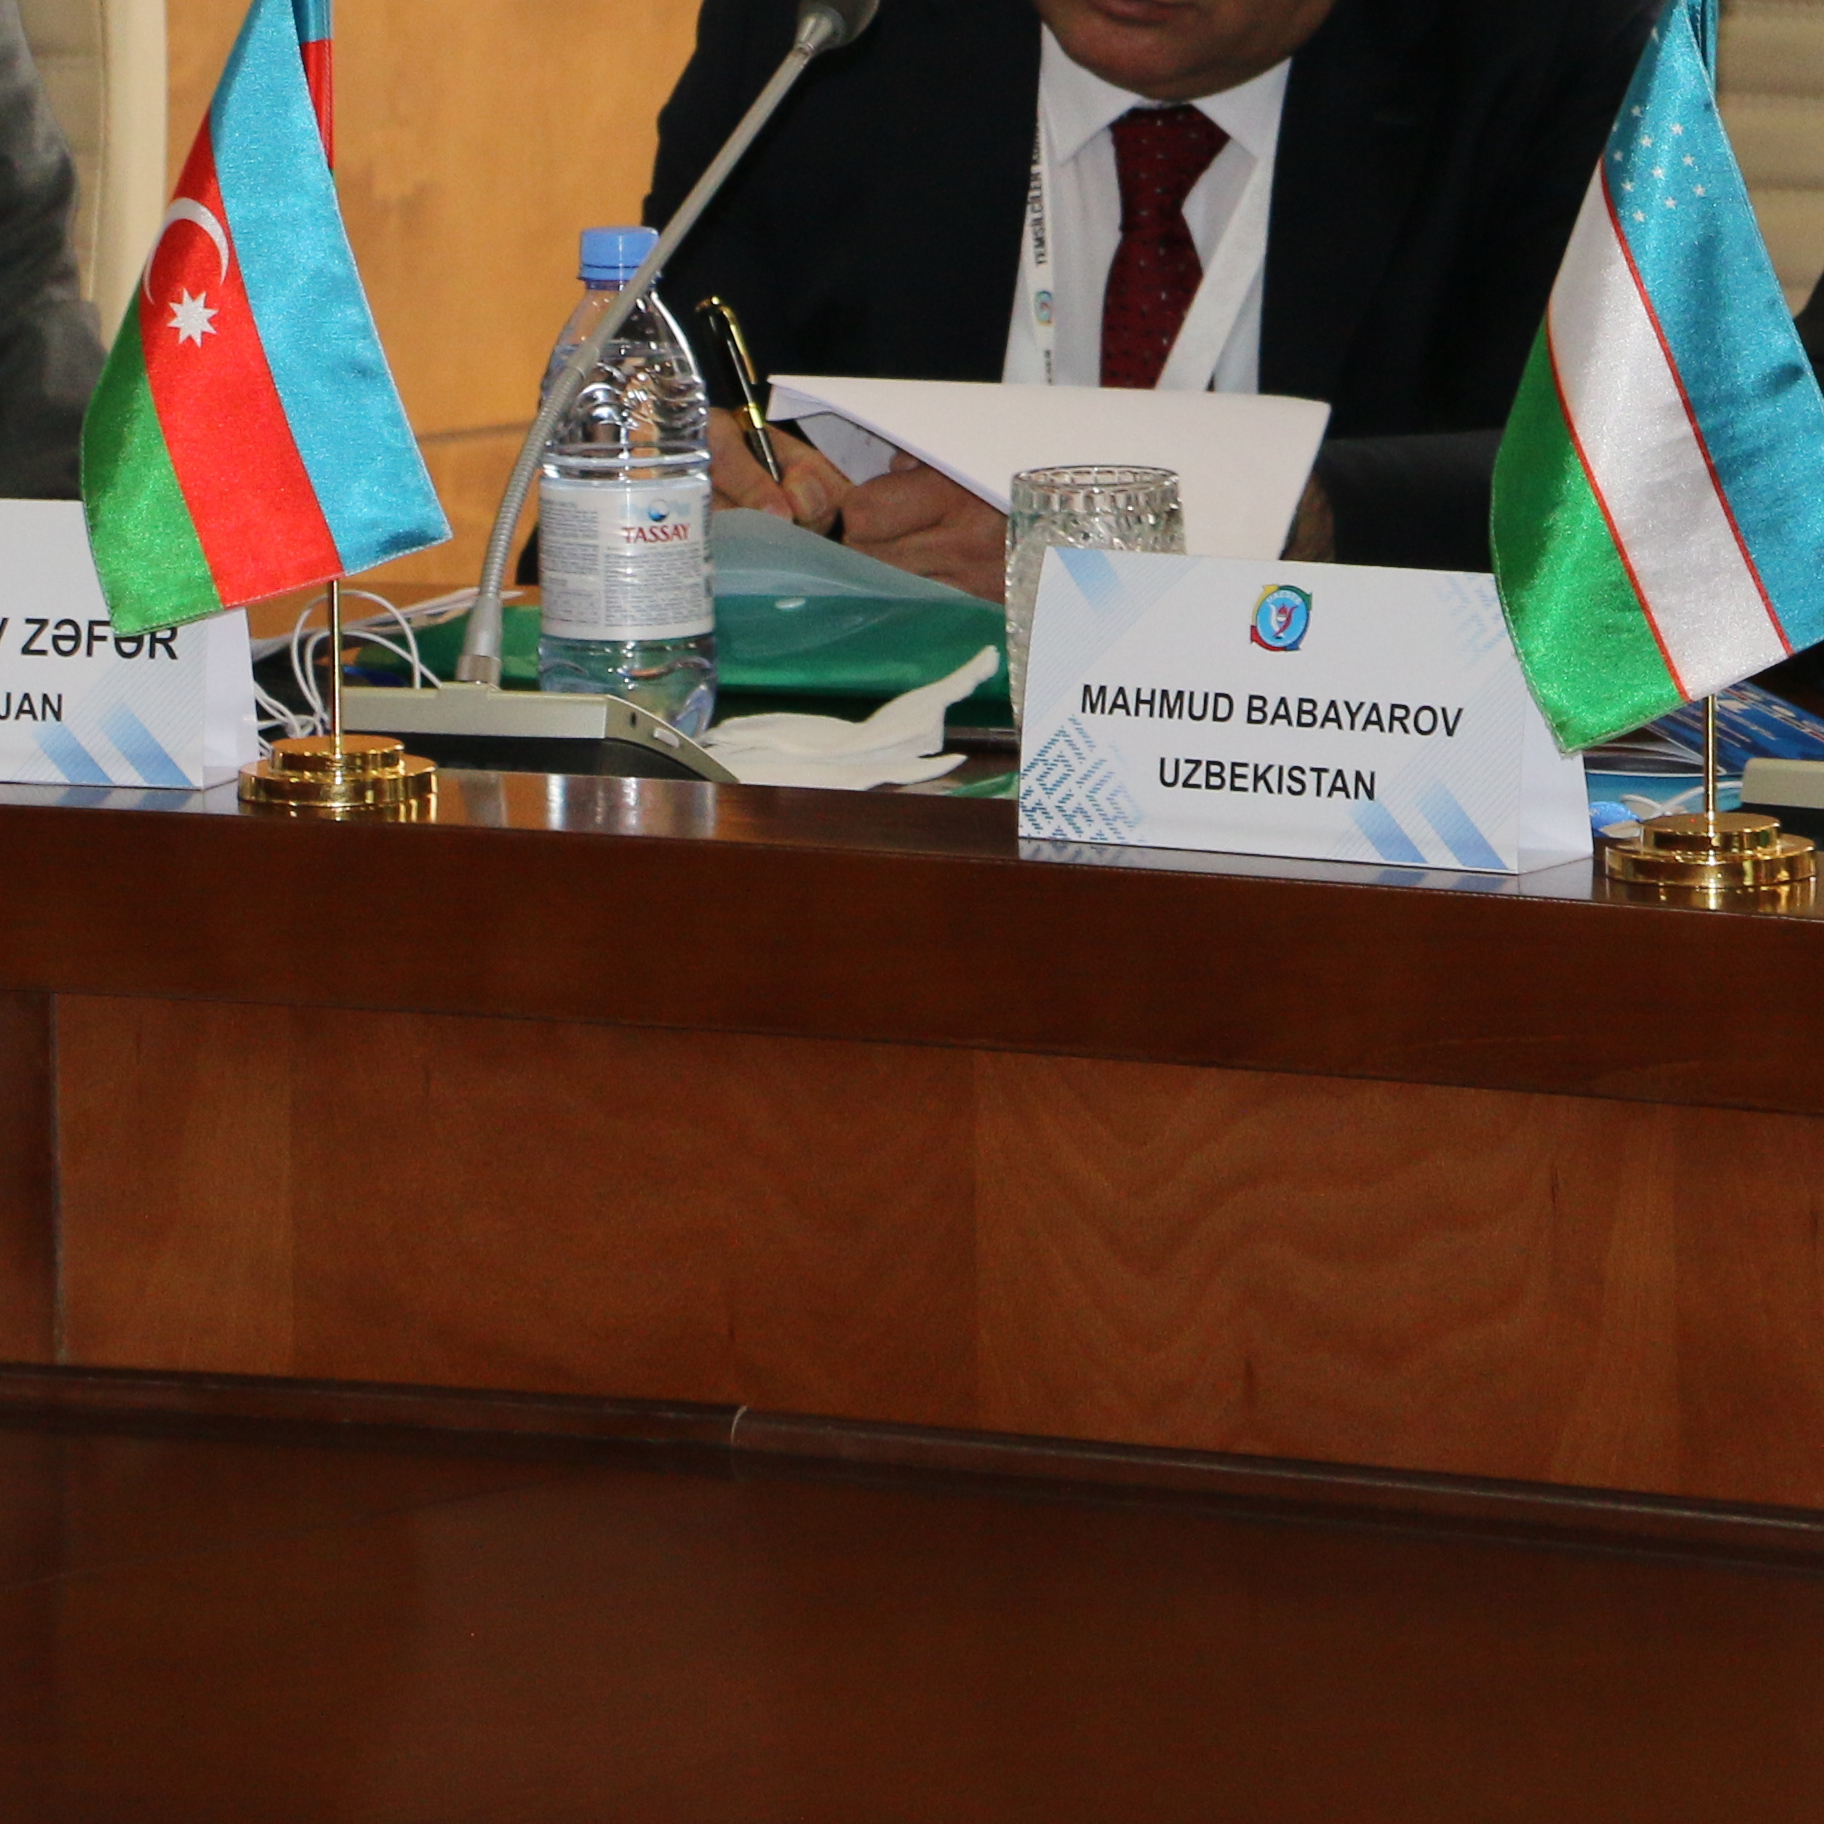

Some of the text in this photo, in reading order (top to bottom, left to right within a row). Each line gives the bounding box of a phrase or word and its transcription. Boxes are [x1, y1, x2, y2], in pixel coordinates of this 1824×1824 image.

[621, 523, 691, 544] TASSAY
[1081, 684, 1464, 738] MAHMUD BABAYAROV
[1158, 757, 1376, 801] UZBEKISTAN
